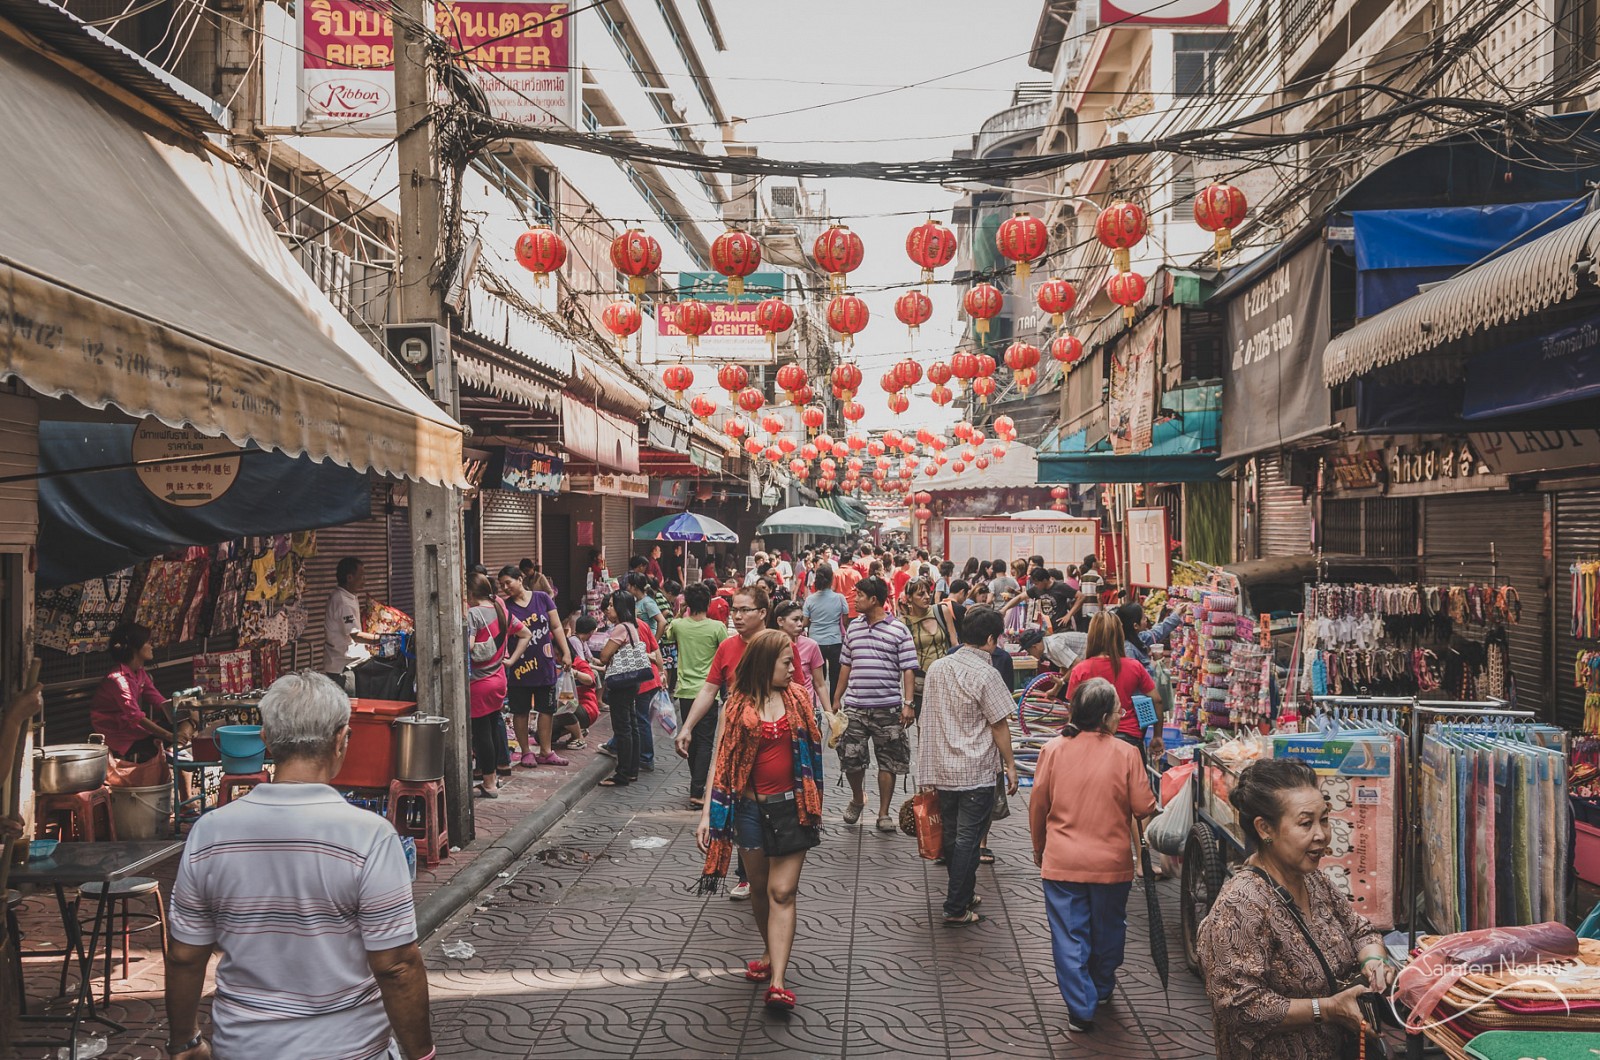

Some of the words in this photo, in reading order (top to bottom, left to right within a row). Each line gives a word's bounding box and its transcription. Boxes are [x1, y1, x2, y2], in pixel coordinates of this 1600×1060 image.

[326, 44, 395, 67] RIBB
[449, 45, 551, 69] ENTER
[319, 84, 379, 110] Ribbon
[1356, 833, 1369, 875] Strolling
